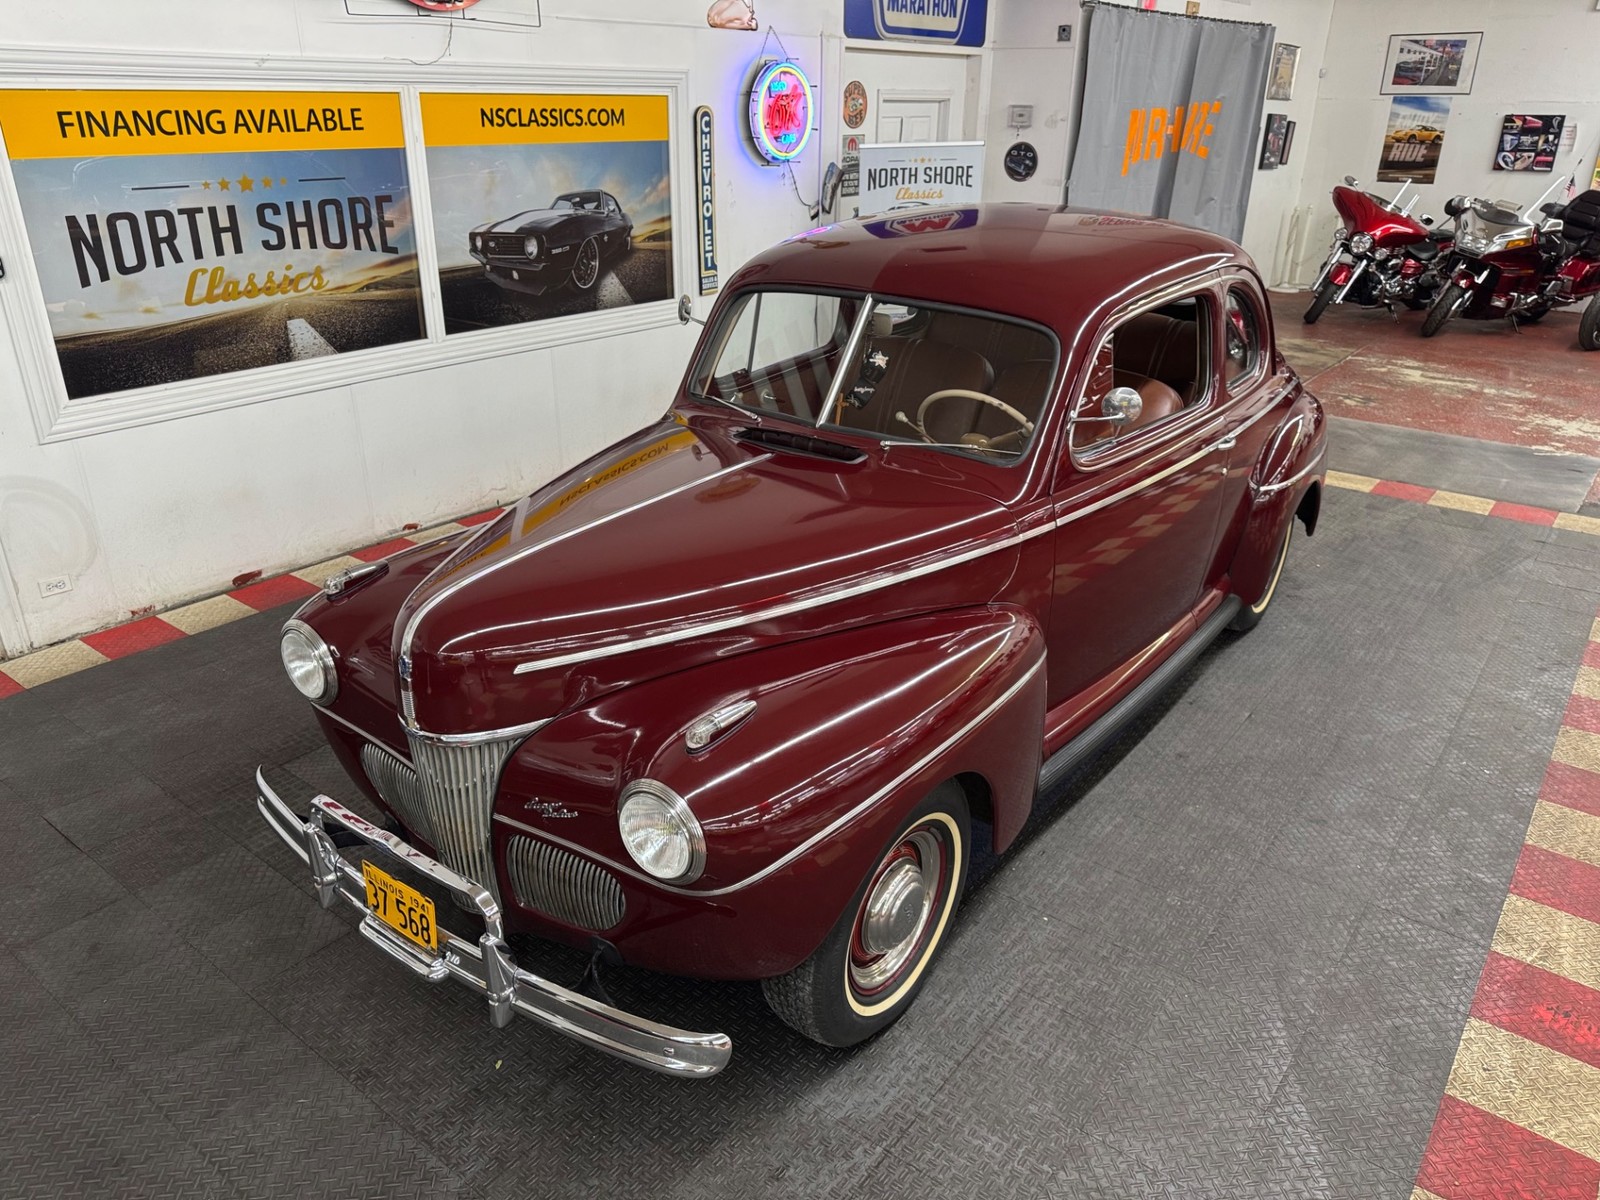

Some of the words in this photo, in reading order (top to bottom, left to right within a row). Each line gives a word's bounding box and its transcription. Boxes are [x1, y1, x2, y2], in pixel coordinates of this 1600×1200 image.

[887, 0, 957, 18] MARATHON
[57, 108, 226, 138] FINANCING
[233, 107, 365, 135] AVAILABLE
[480, 106, 625, 128] NSCLASSICS.COM
[848, 109, 864, 126] BEE
[842, 155, 860, 164] MOPA
[1010, 149, 1034, 158] GTO
[1388, 143, 1428, 162] RIDE
[867, 167, 918, 191] NORTH
[923, 165, 973, 188] SHORE
[701, 115, 713, 268] CHEVROLET
[895, 186, 944, 201] Classics
[64, 204, 242, 288] NORTH
[259, 194, 399, 255] SHORE
[183, 264, 329, 307] Classics
[364, 868, 404, 900] ILLINOIS
[409, 895, 430, 916] 1941
[367, 880, 388, 917] 37
[395, 897, 432, 945] 568
